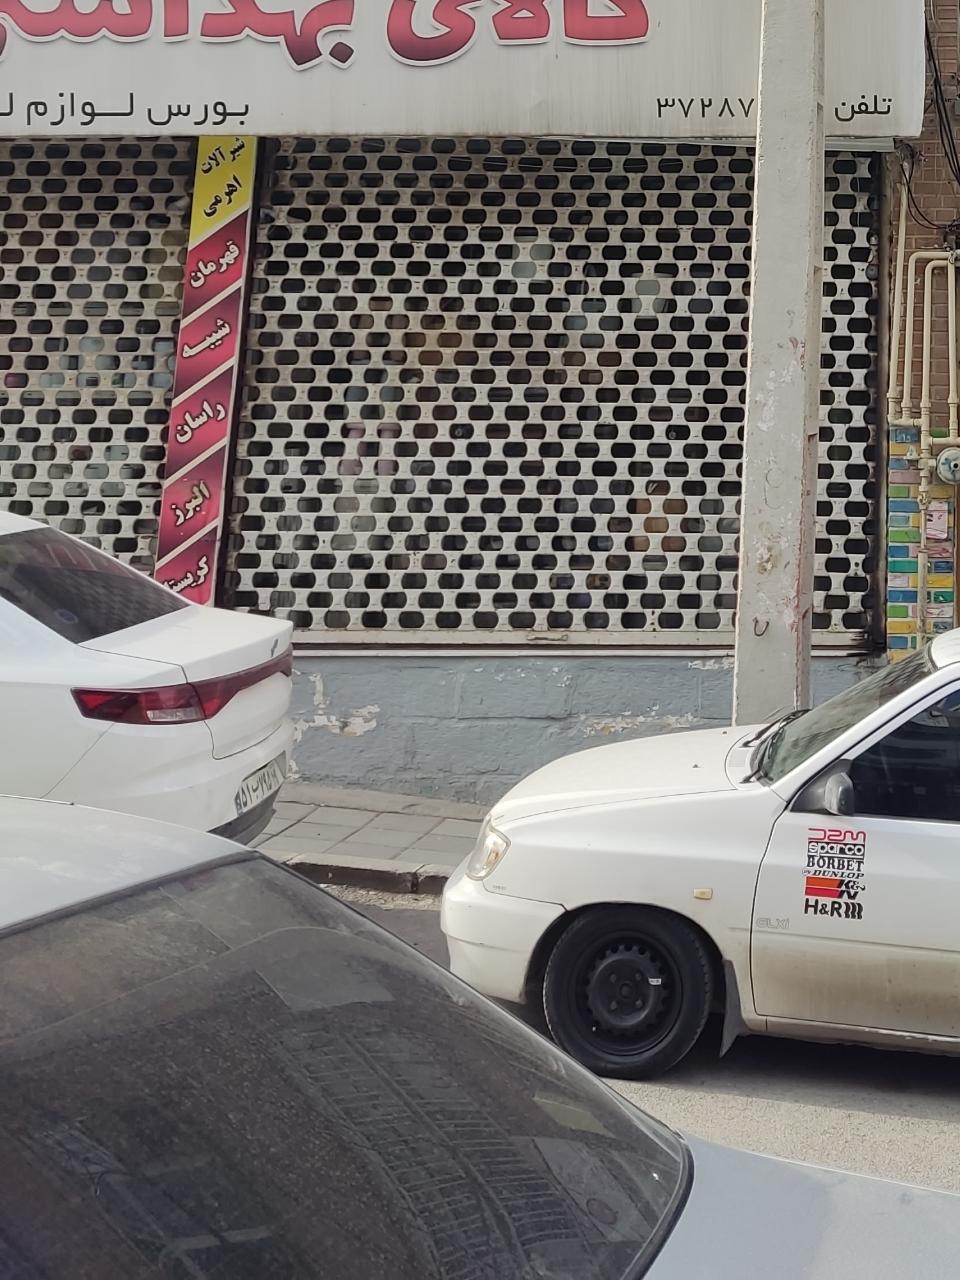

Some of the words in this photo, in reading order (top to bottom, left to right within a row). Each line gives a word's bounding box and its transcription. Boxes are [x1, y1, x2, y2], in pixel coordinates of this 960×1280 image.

[27, 92, 135, 126] لوازم
[147, 102, 250, 126] بورس
[835, 94, 892, 121] تلفن
[201, 146, 226, 174] آلات
[229, 136, 246, 162] شیر
[189, 240, 240, 288] قهرمان
[176, 400, 226, 443] راسان
[171, 480, 211, 526] البرز
[808, 841, 865, 857] sparco
[806, 855, 865, 871] BORBET
[813, 869, 865, 879] DUNLOP
[804, 898, 842, 918] H&R
